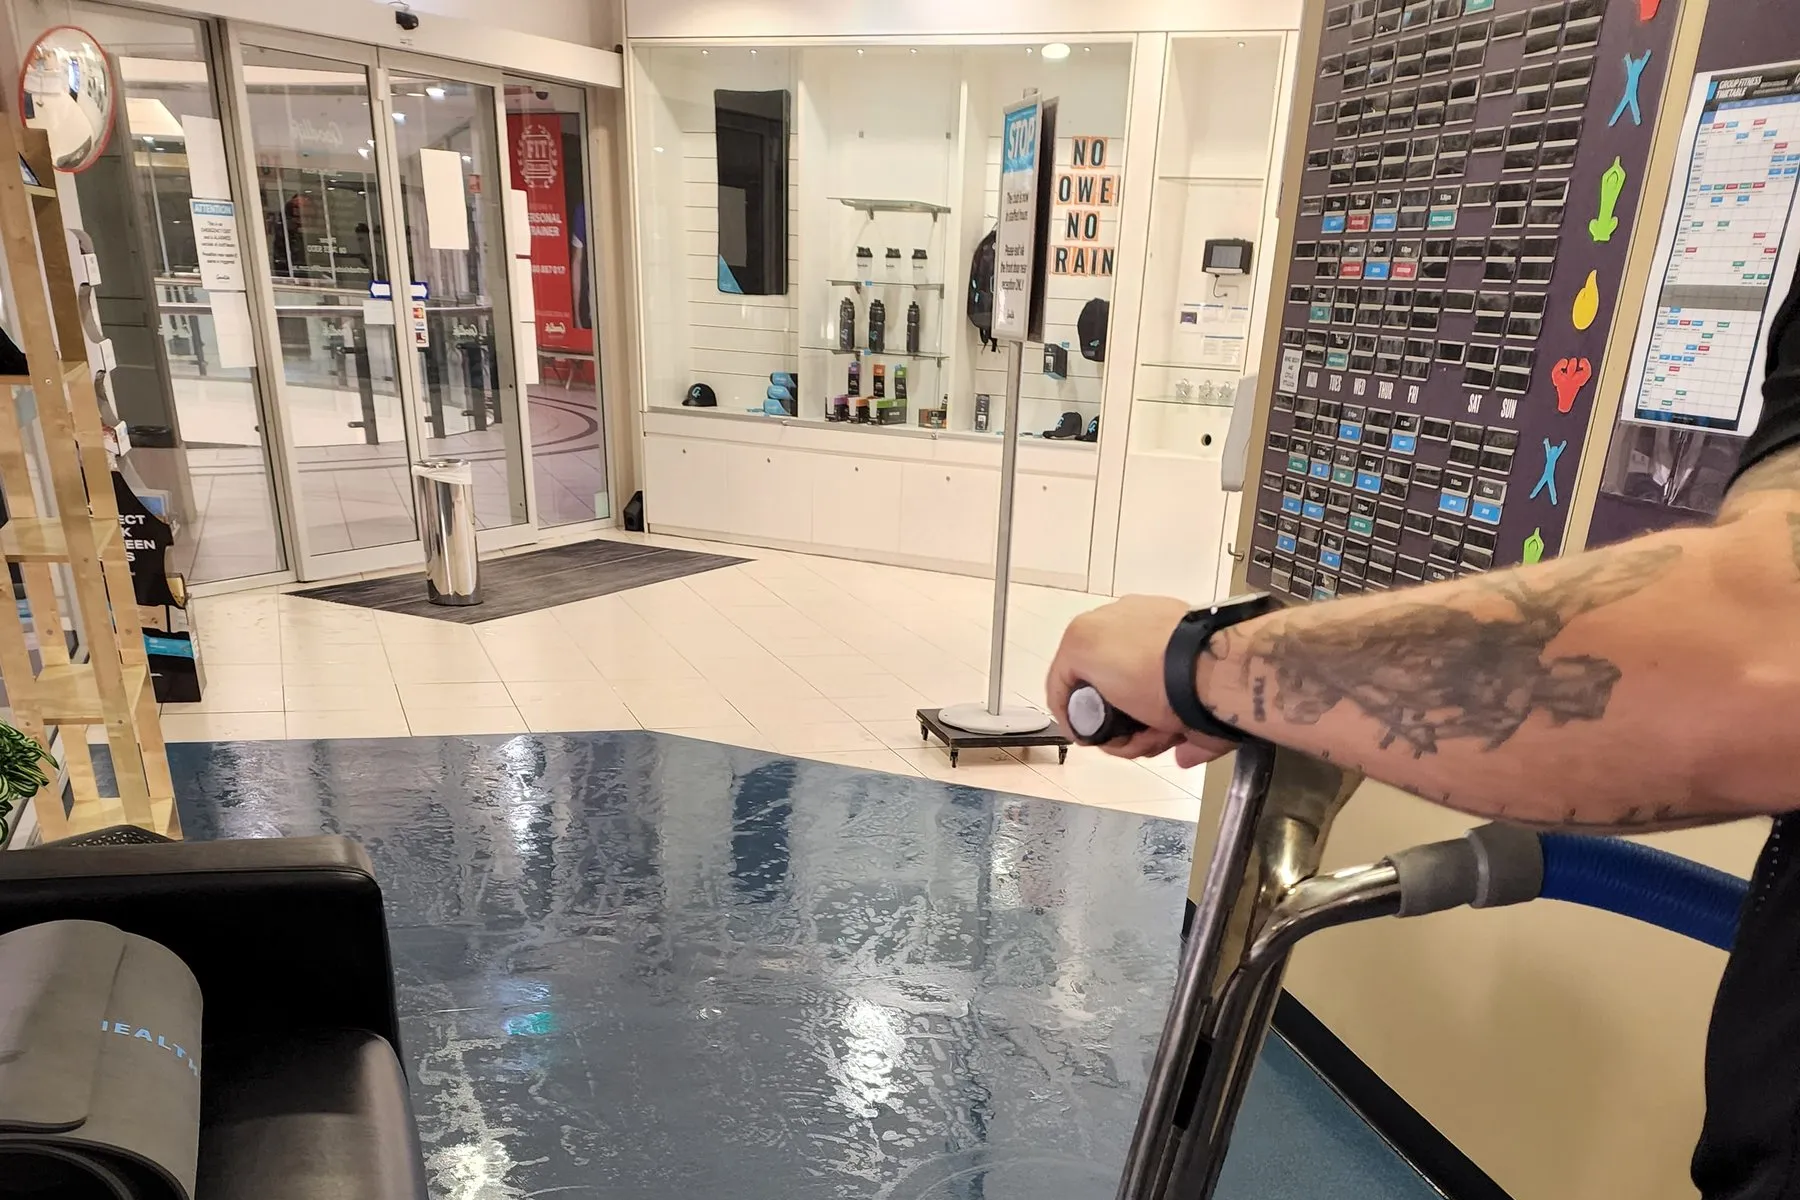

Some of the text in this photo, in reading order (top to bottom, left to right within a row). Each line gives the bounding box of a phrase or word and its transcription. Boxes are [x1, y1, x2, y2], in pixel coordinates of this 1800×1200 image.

[1719, 75, 1763, 89] GROUP FITNESS
[1715, 86, 1748, 99] TIMETABLE
[1008, 116, 1035, 160] STOP
[527, 140, 547, 158] FIT
[1073, 138, 1105, 167] NO
[1058, 175, 1120, 204] OWE
[1066, 212, 1098, 240] NO
[1055, 247, 1113, 275] RAIN
[1328, 374, 1343, 392] TUES
[1353, 377, 1367, 395] WED
[1378, 381, 1394, 400] THUR
[1407, 385, 1420, 404] FRI
[1467, 393, 1482, 414] SAT
[1500, 398, 1518, 419] SUN
